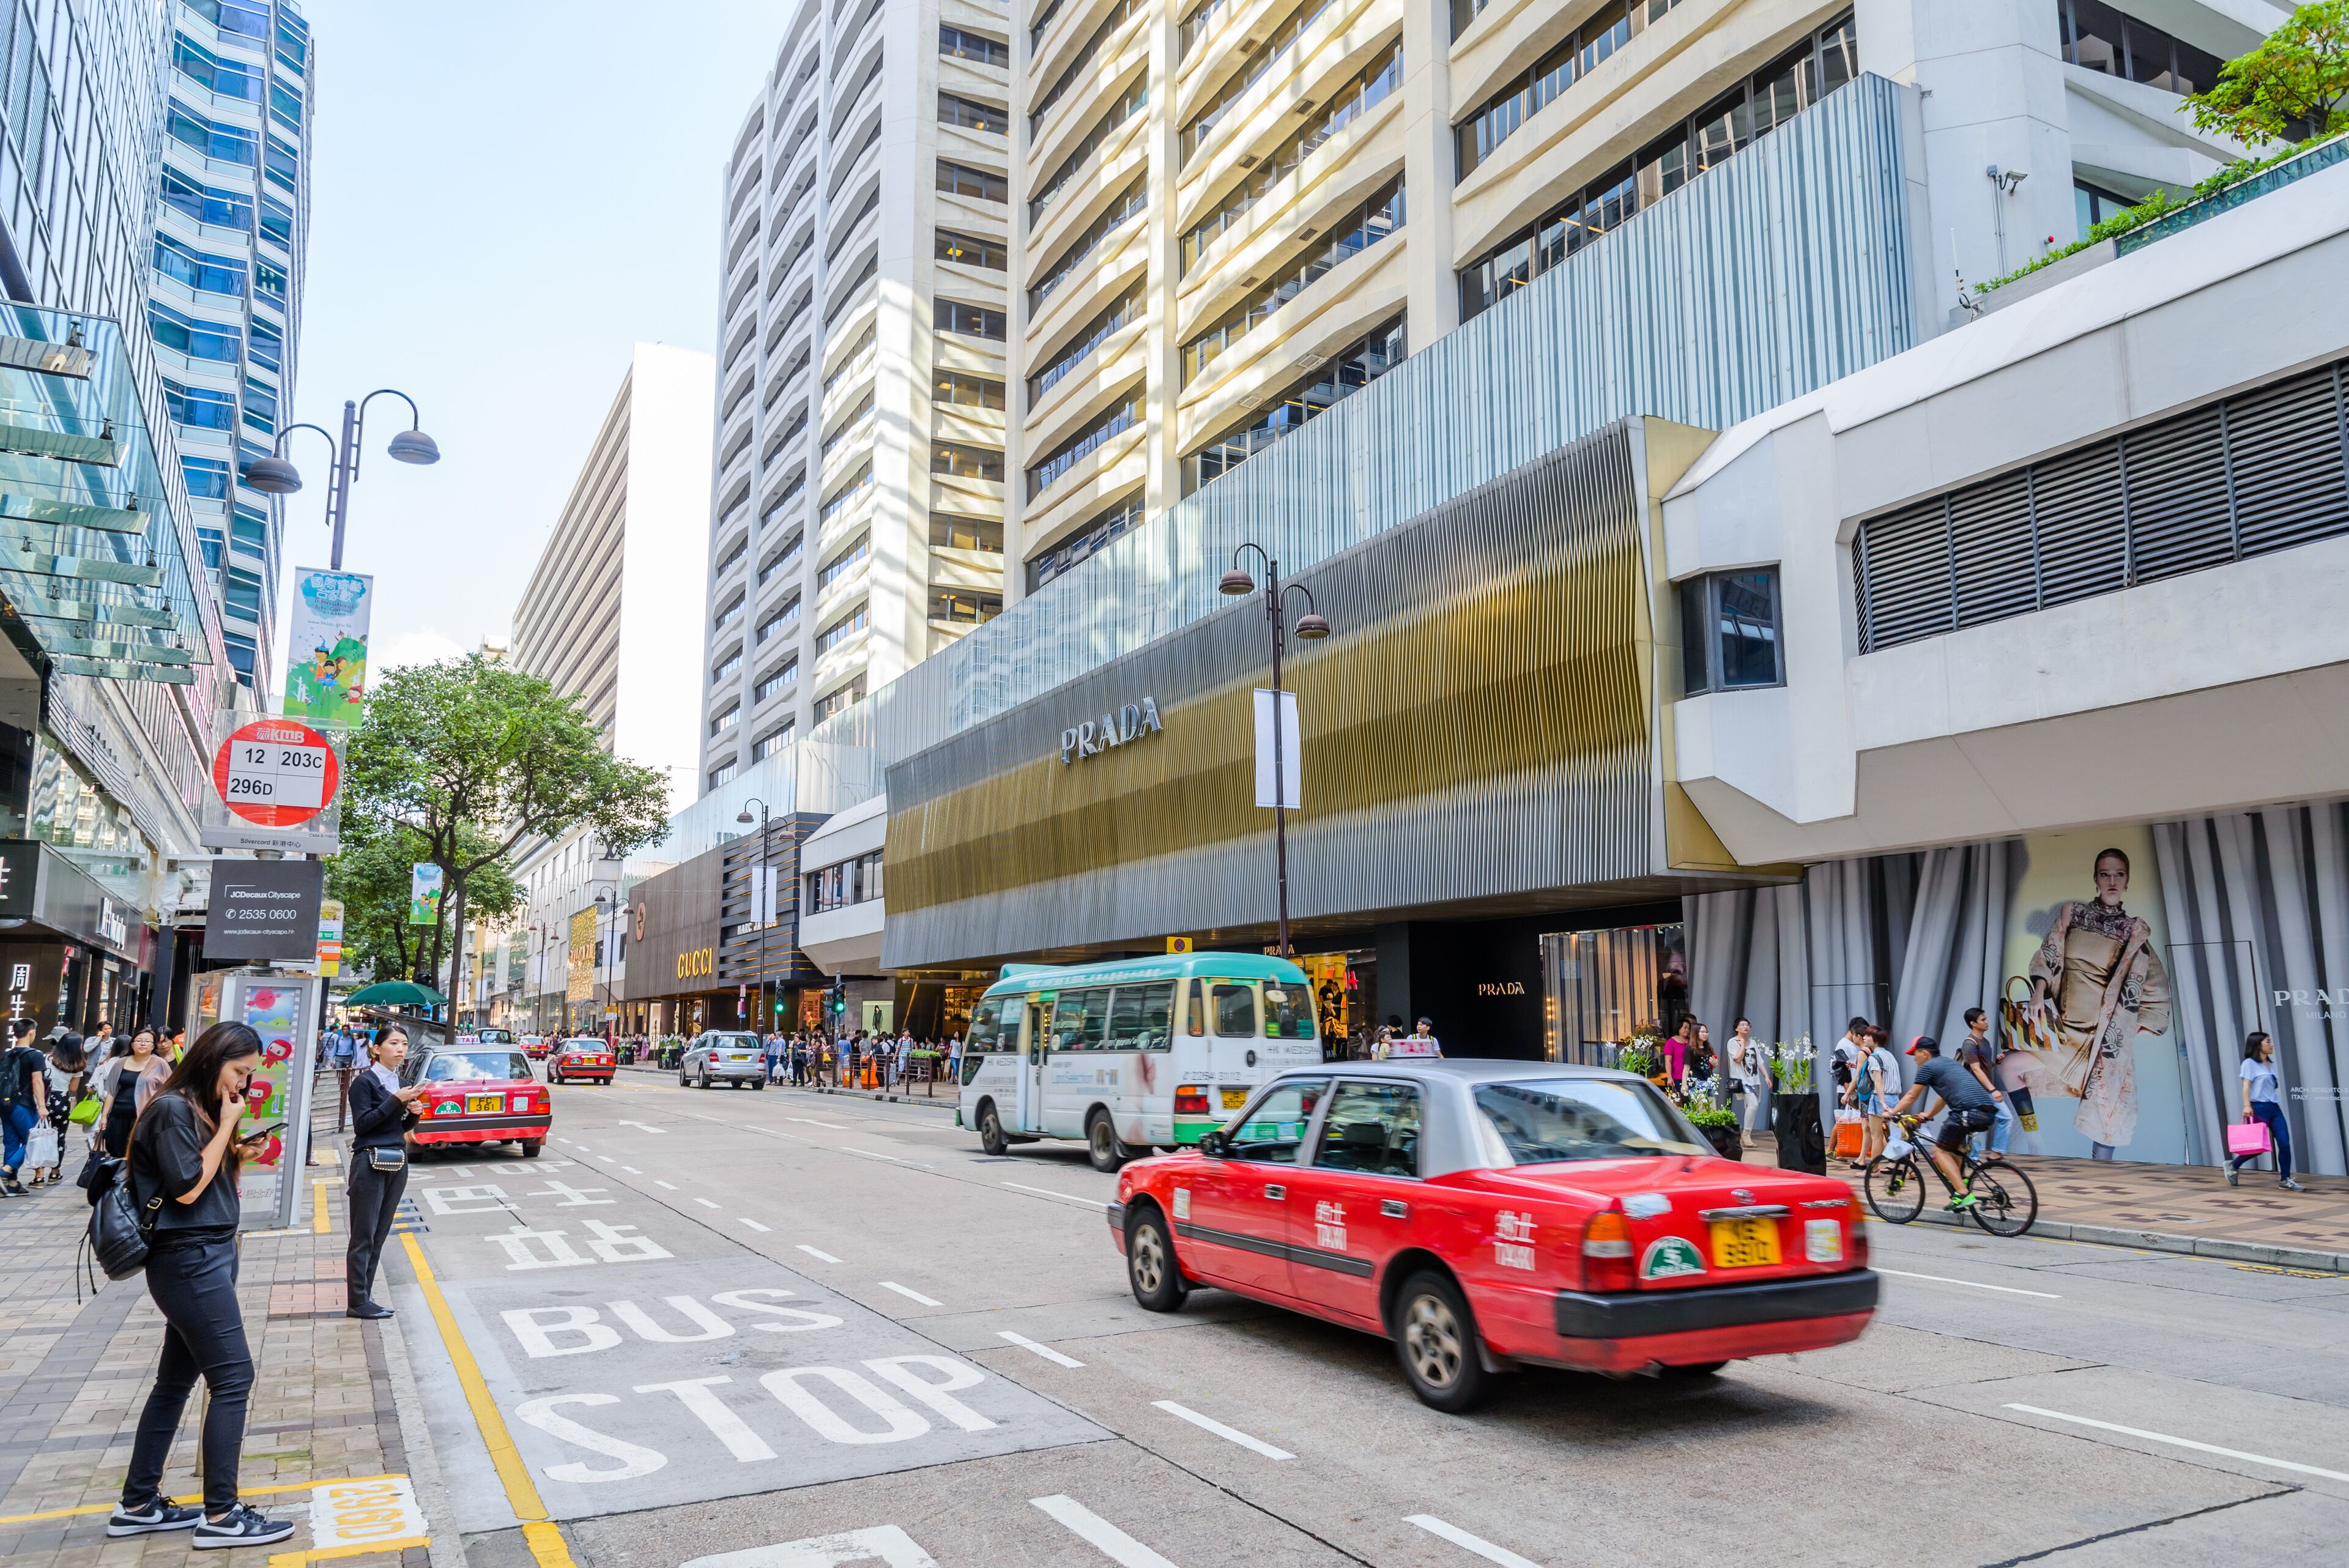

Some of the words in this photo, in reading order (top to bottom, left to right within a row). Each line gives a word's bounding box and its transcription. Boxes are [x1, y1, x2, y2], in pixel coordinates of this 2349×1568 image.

[314, 597, 354, 609] International
[270, 729, 305, 743] KMB
[1061, 696, 1163, 766] PRADA
[245, 748, 265, 764] 12
[281, 751, 322, 768] 203C
[230, 778, 272, 795] 296D
[272, 839, 301, 848] 新港中心
[239, 909, 267, 920] 2535
[269, 909, 297, 920] 0600
[737, 923, 754, 935] MARC
[1264, 943, 1295, 956] PRAA
[677, 947, 713, 979] GUCCI
[1479, 981, 1525, 995] PRADA
[2306, 1011, 2347, 1019] MILANO
[1315, 1222, 1348, 1251] TAXI
[499, 1288, 844, 1359] BUS
[514, 1354, 1003, 1484] STOP
[329, 1483, 407, 1539] 296D
